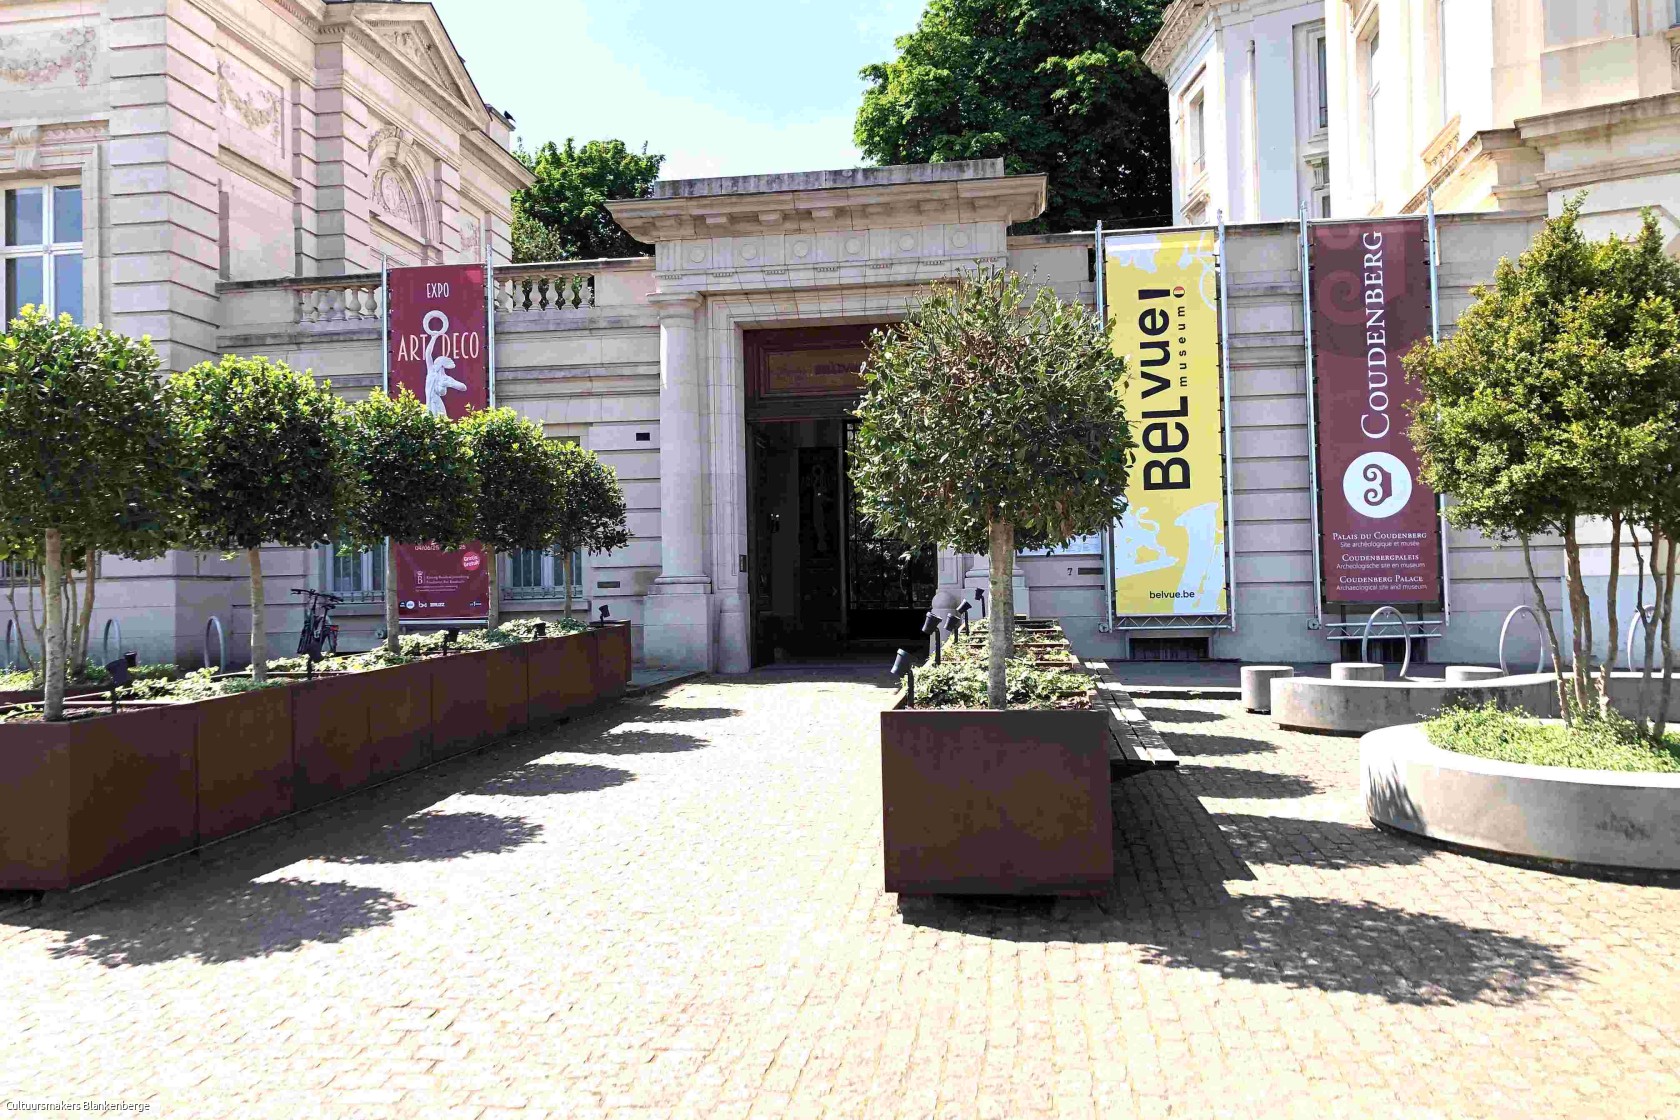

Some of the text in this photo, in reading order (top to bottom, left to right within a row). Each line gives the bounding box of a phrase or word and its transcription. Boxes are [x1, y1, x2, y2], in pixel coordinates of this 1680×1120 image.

[426, 282, 450, 298] EXPO
[397, 331, 479, 361] ART DECO
[1177, 305, 1188, 387] museum
[1066, 567, 1073, 576] 7
[1336, 584, 1378, 592] Archaeological
[1149, 590, 1195, 600] belvue.be
